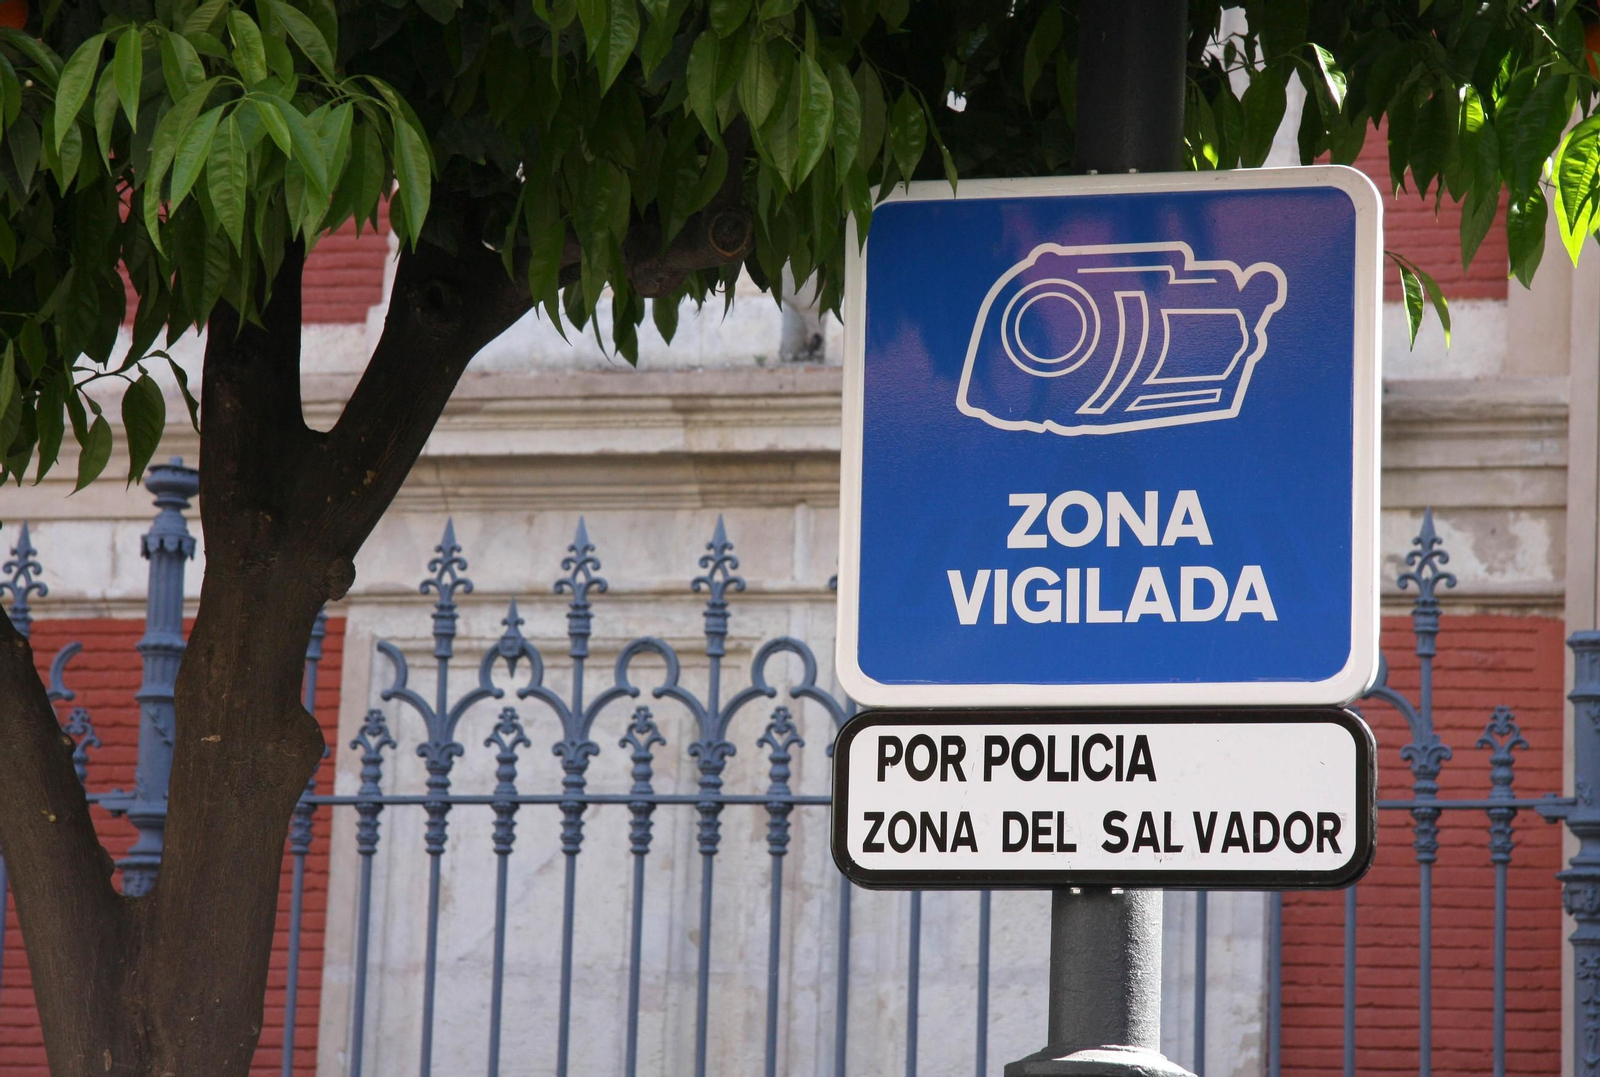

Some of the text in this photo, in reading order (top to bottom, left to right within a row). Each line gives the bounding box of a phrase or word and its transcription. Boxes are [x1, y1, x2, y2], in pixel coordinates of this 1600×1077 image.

[1006, 489, 1213, 549] ZONA
[946, 564, 1279, 626] VIGILADA
[877, 732, 1157, 783] POR POLICIA
[862, 810, 979, 853] ZONA
[1002, 810, 1077, 853] DEL
